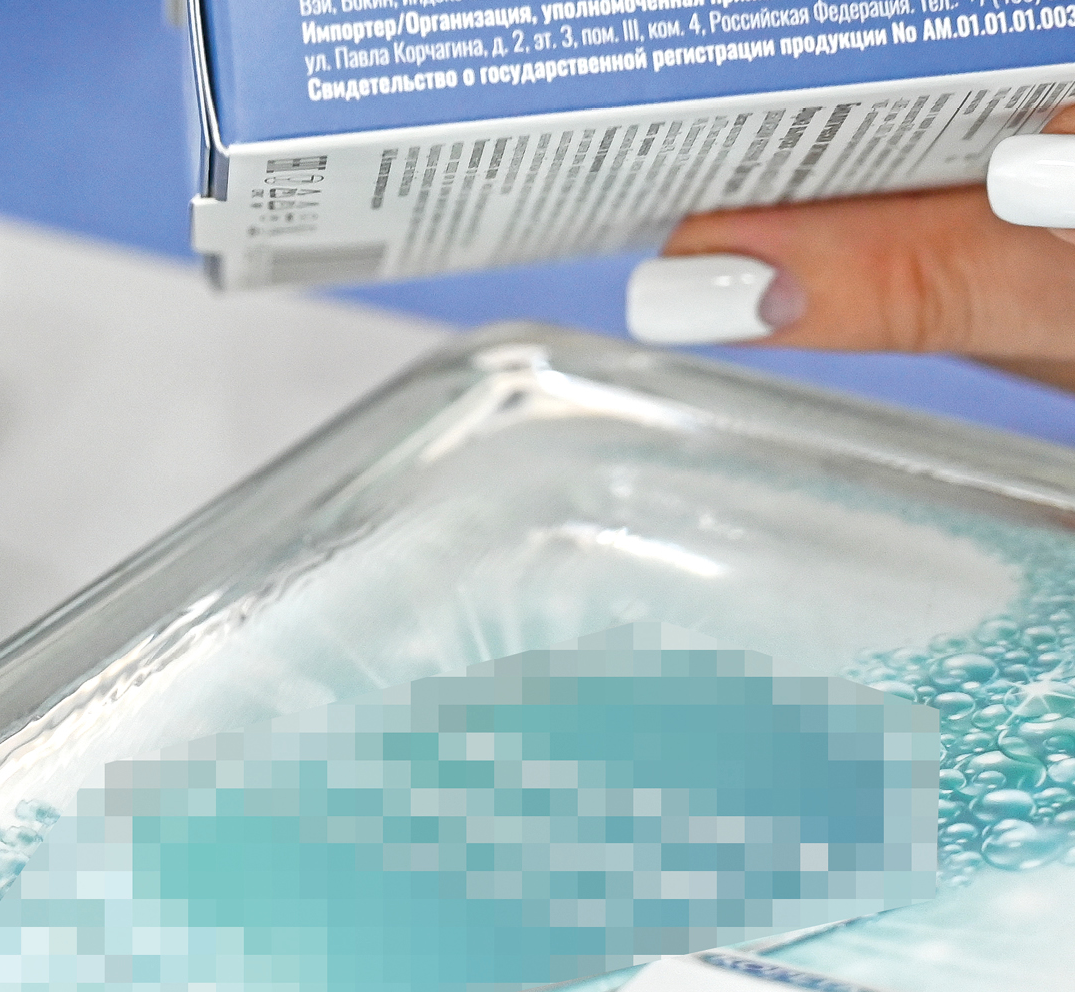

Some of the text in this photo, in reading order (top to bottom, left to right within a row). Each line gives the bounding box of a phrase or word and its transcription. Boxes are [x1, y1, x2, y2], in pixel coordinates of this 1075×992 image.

[301, 5, 539, 45] Импортер/Организация,
[304, 53, 332, 76] ул.
[334, 45, 391, 70] Павла
[393, 38, 489, 67] Корчагина,
[491, 36, 509, 58] д.
[511, 28, 531, 54] 2,
[533, 31, 557, 51] эт.
[559, 24, 579, 49] 3,
[581, 25, 620, 46] пом.
[622, 18, 645, 43] III,
[647, 19, 686, 40] ком.
[688, 12, 707, 37] 4,
[708, 6, 811, 34] Российская
[307, 69, 459, 102] Свидетельство
[462, 67, 476, 87] о
[479, 46, 648, 86] государственной
[652, 38, 776, 73] регистрации
[779, 27, 888, 60] продукции
